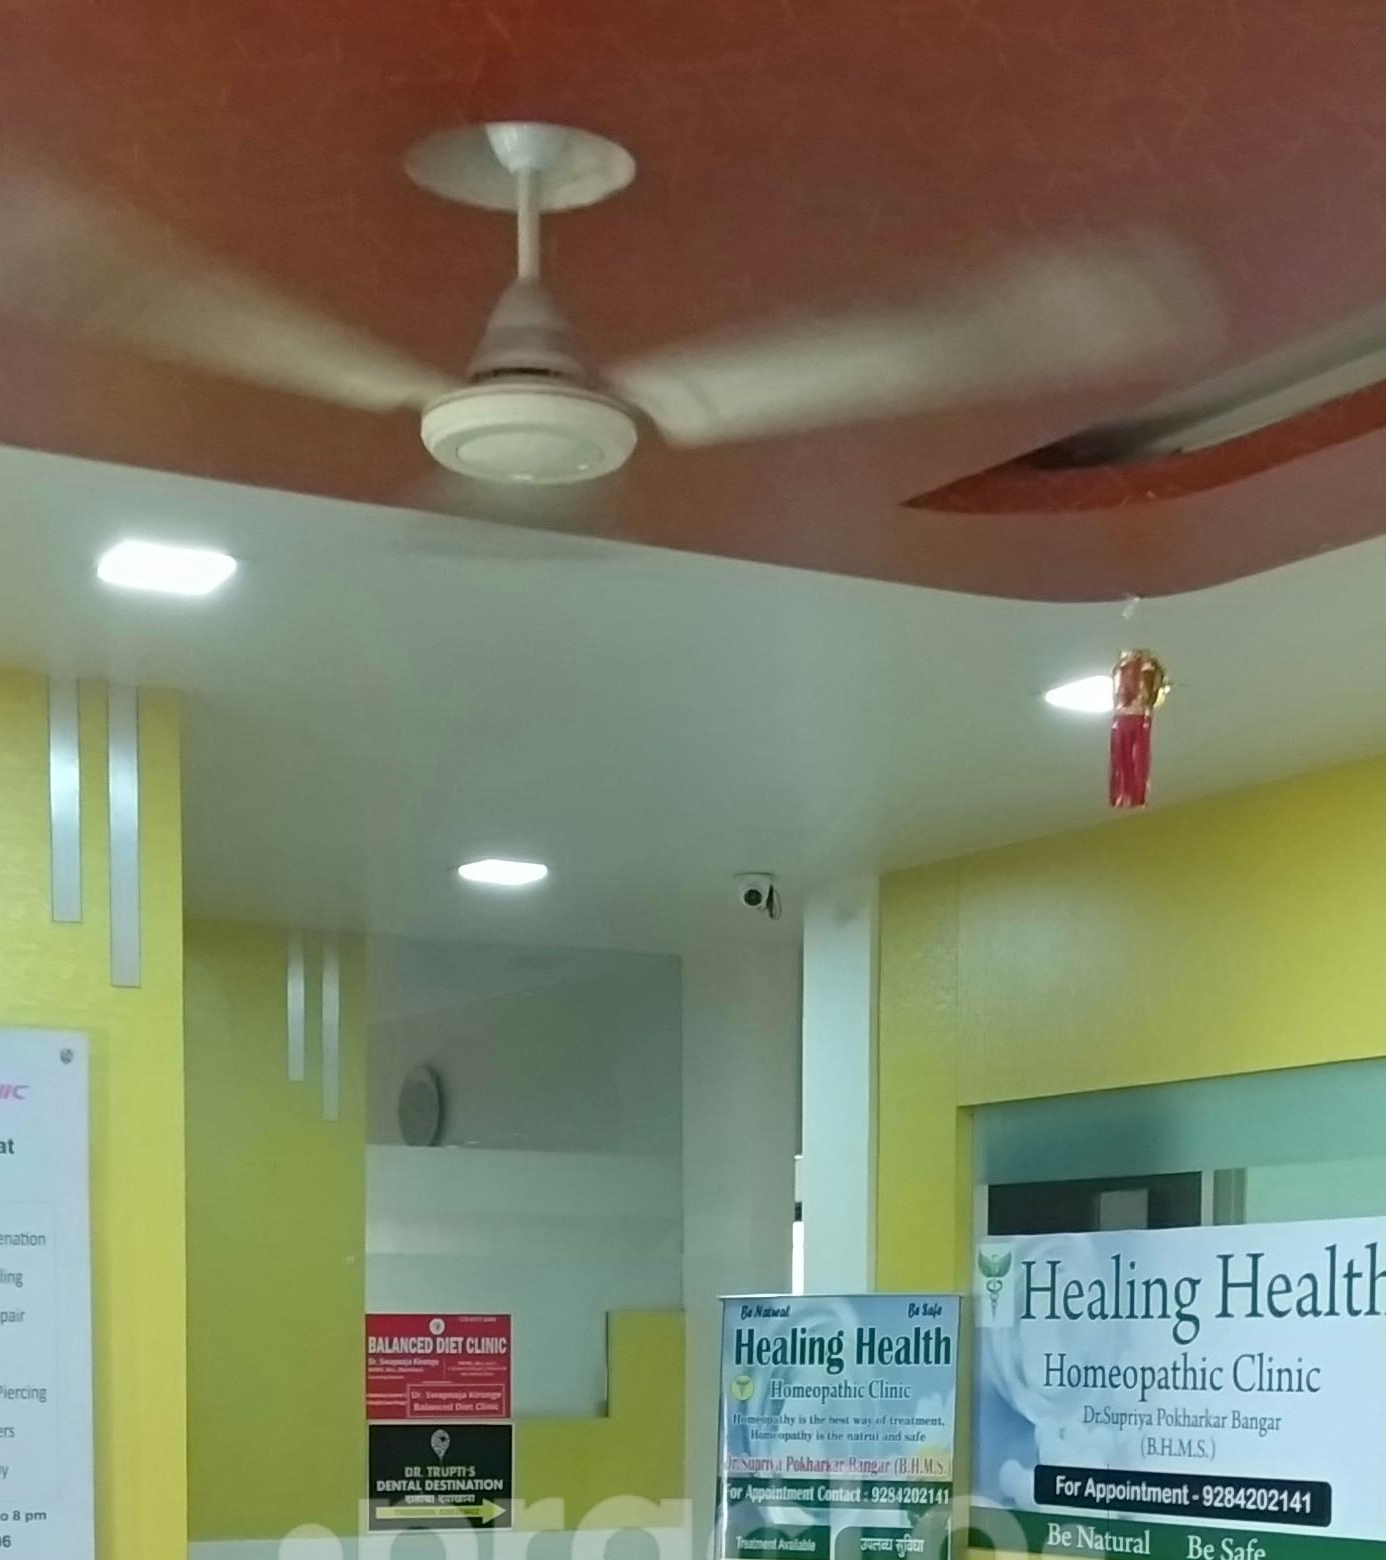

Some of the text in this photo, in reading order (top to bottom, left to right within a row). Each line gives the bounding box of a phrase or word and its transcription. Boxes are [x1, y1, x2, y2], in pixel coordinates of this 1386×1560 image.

[1020, 1254, 1201, 1345] Healing
[368, 1337, 507, 1353] BALANCED DIET CLINIC
[735, 1327, 951, 1374] Healing Health
[1043, 1352, 1320, 1402] Homeopathic Clinic
[771, 1379, 911, 1403] Homeopathic Clinic
[1083, 1405, 1281, 1436] Dr.Supriya Pokharkar Bangar
[1140, 1437, 1215, 1461] (B.H.M.S.)
[377, 1480, 503, 1491] DENTAL DESTINATION
[746, 1484, 949, 1504] Appointment Contact 9284202141
[1055, 1475, 1311, 1513] For Appointment 9284202141
[737, 1536, 816, 1552] Treatment Available
[1047, 1523, 1150, 1555] Be Natural
[1187, 1535, 1214, 1560] Be
